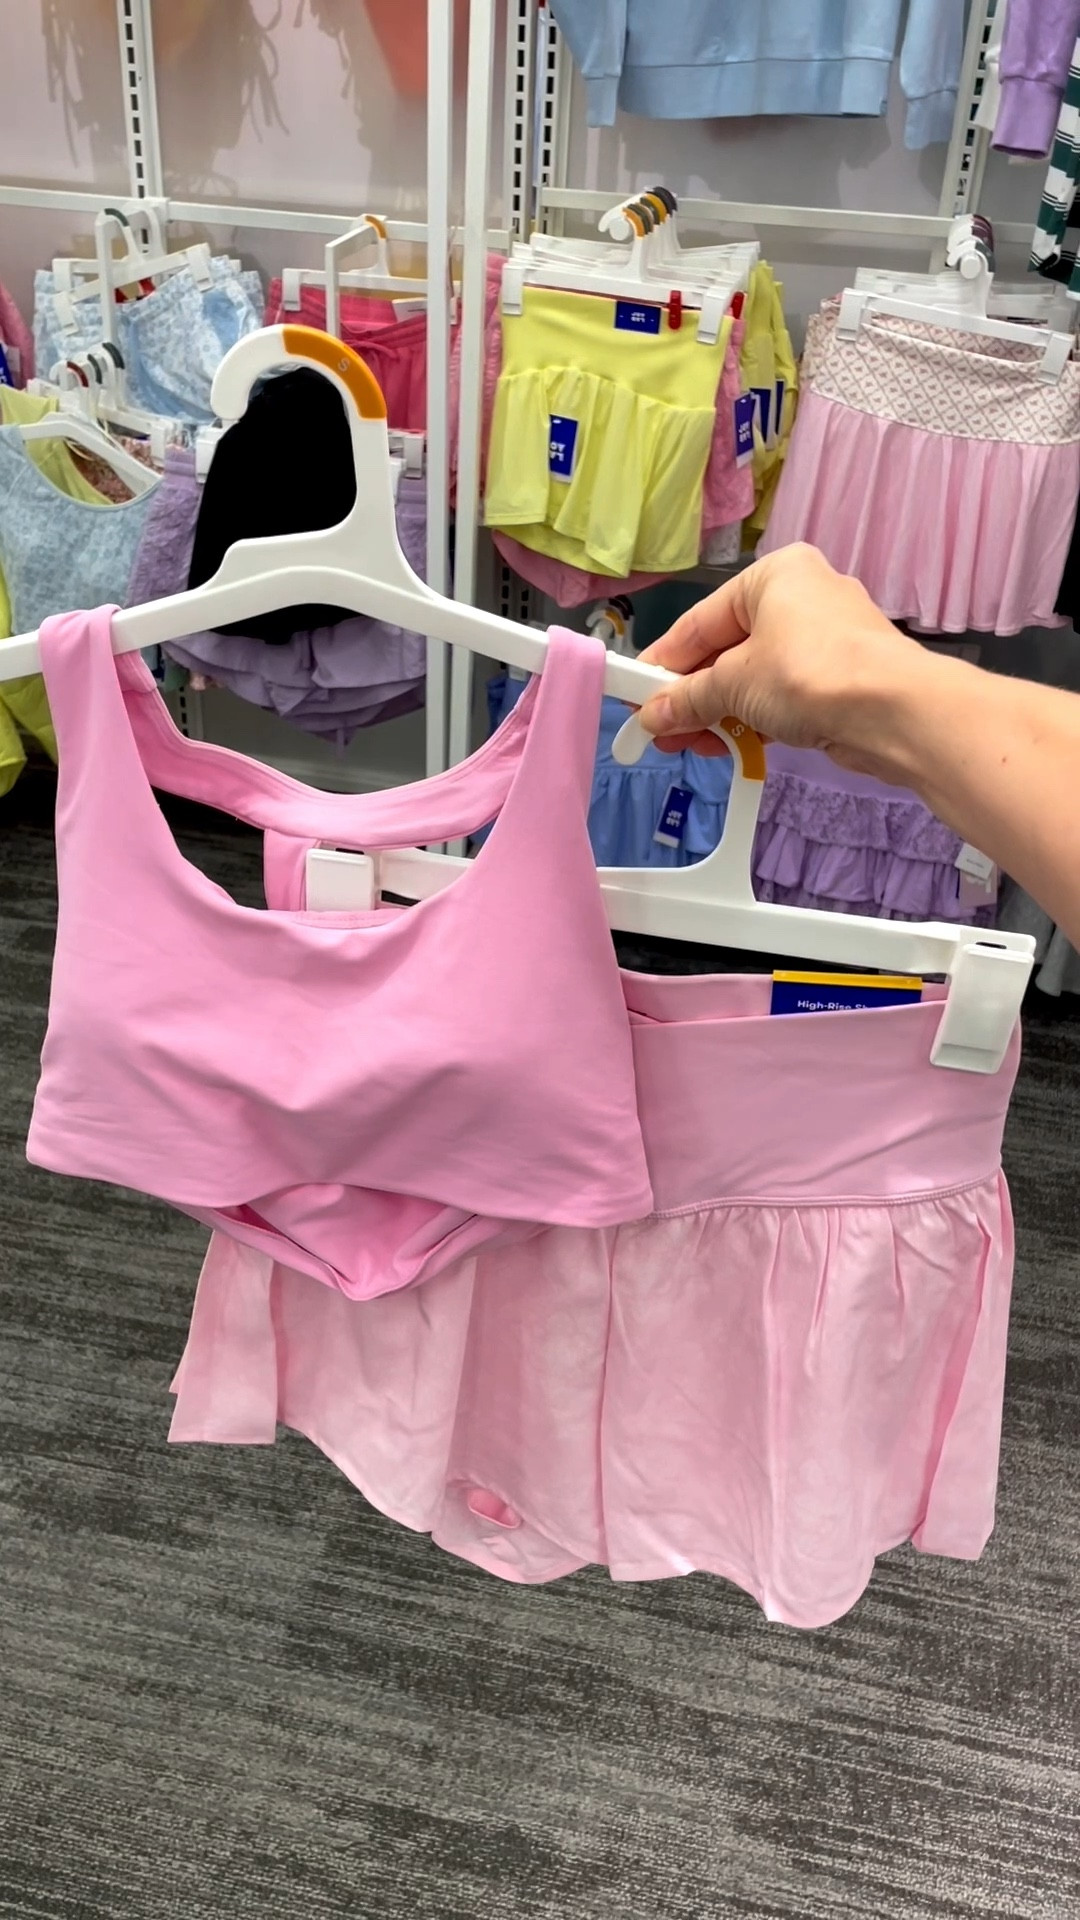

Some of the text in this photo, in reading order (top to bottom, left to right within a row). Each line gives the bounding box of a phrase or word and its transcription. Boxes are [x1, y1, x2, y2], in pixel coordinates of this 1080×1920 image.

[338, 358, 350, 371] S
[550, 441, 566, 453] OY
[731, 724, 745, 737] S
[797, 1000, 852, 1010] High-Rise
